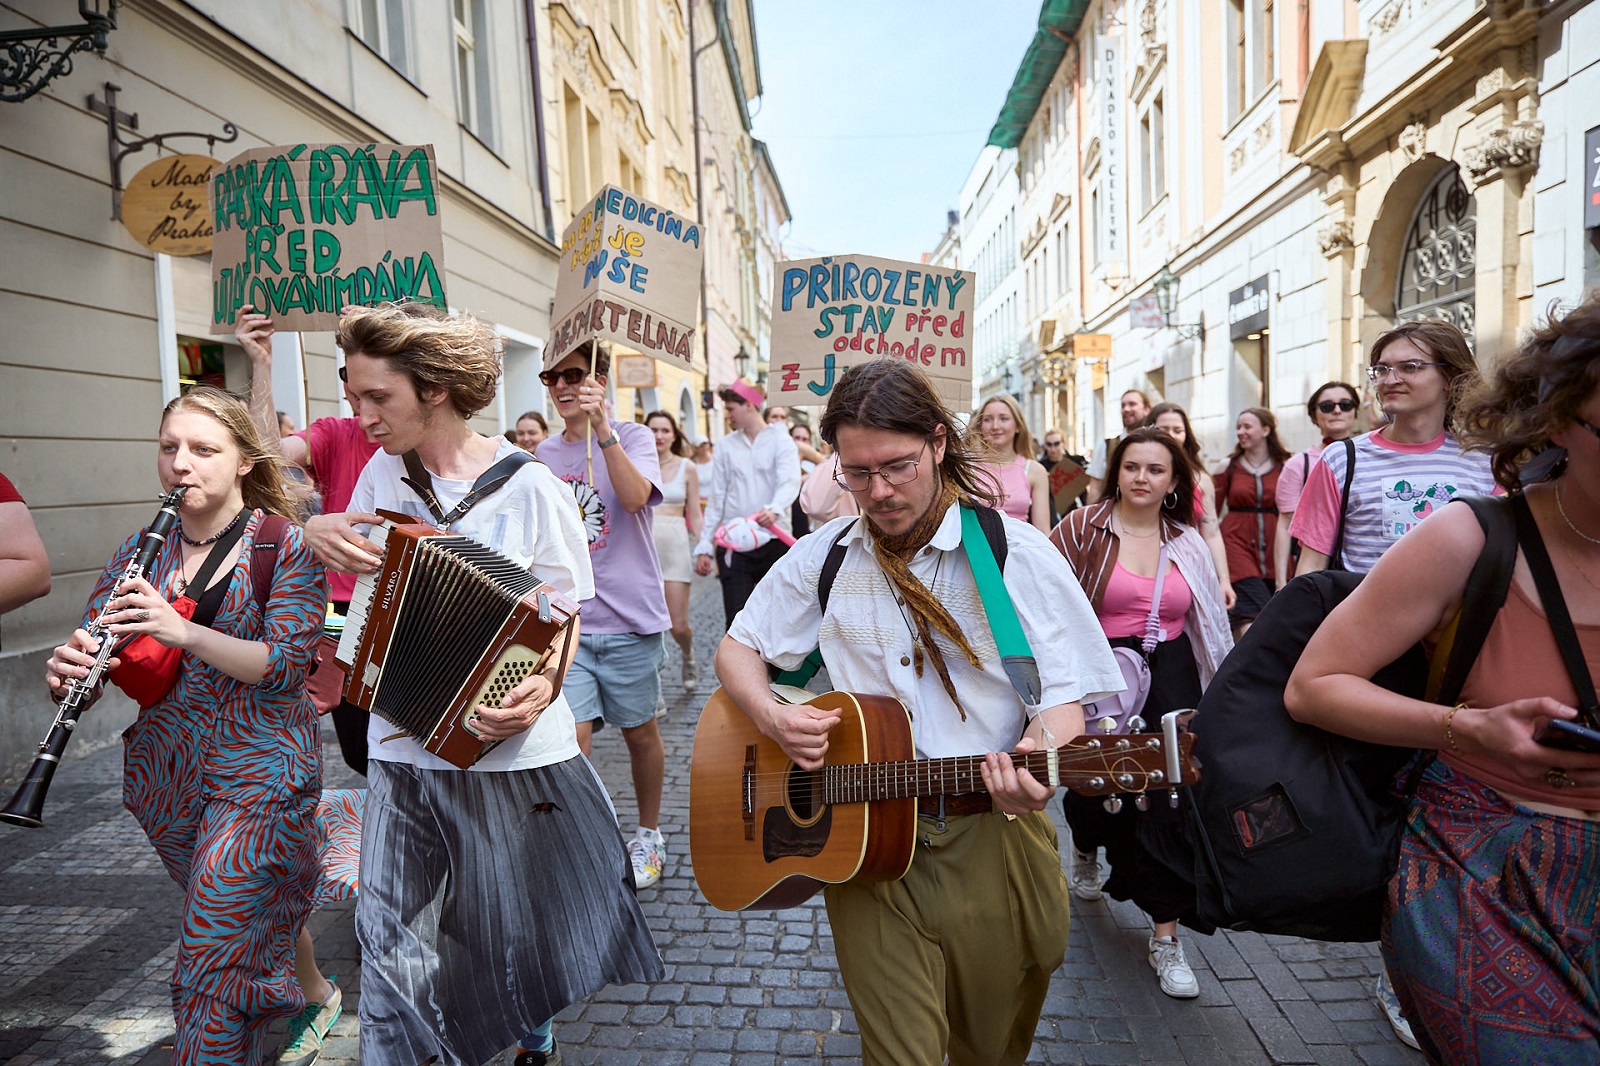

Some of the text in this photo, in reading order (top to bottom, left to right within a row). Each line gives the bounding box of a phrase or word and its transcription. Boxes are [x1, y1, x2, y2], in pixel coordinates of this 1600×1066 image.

[1105, 50, 1116, 140] DIVADLO
[151, 160, 211, 188] Mad
[309, 144, 437, 226] PRÁVA
[170, 191, 202, 220] by
[594, 188, 700, 249] MEDICÍNA
[245, 224, 341, 275] PŘED
[608, 224, 645, 257] je
[583, 249, 649, 294] DUŠE
[782, 256, 966, 312] PŘIROZENÝ
[550, 299, 695, 363] NESMRTELNÁ
[814, 304, 895, 338] STAV
[833, 327, 966, 368] odchodem
[381, 571, 398, 610] SILVARO
